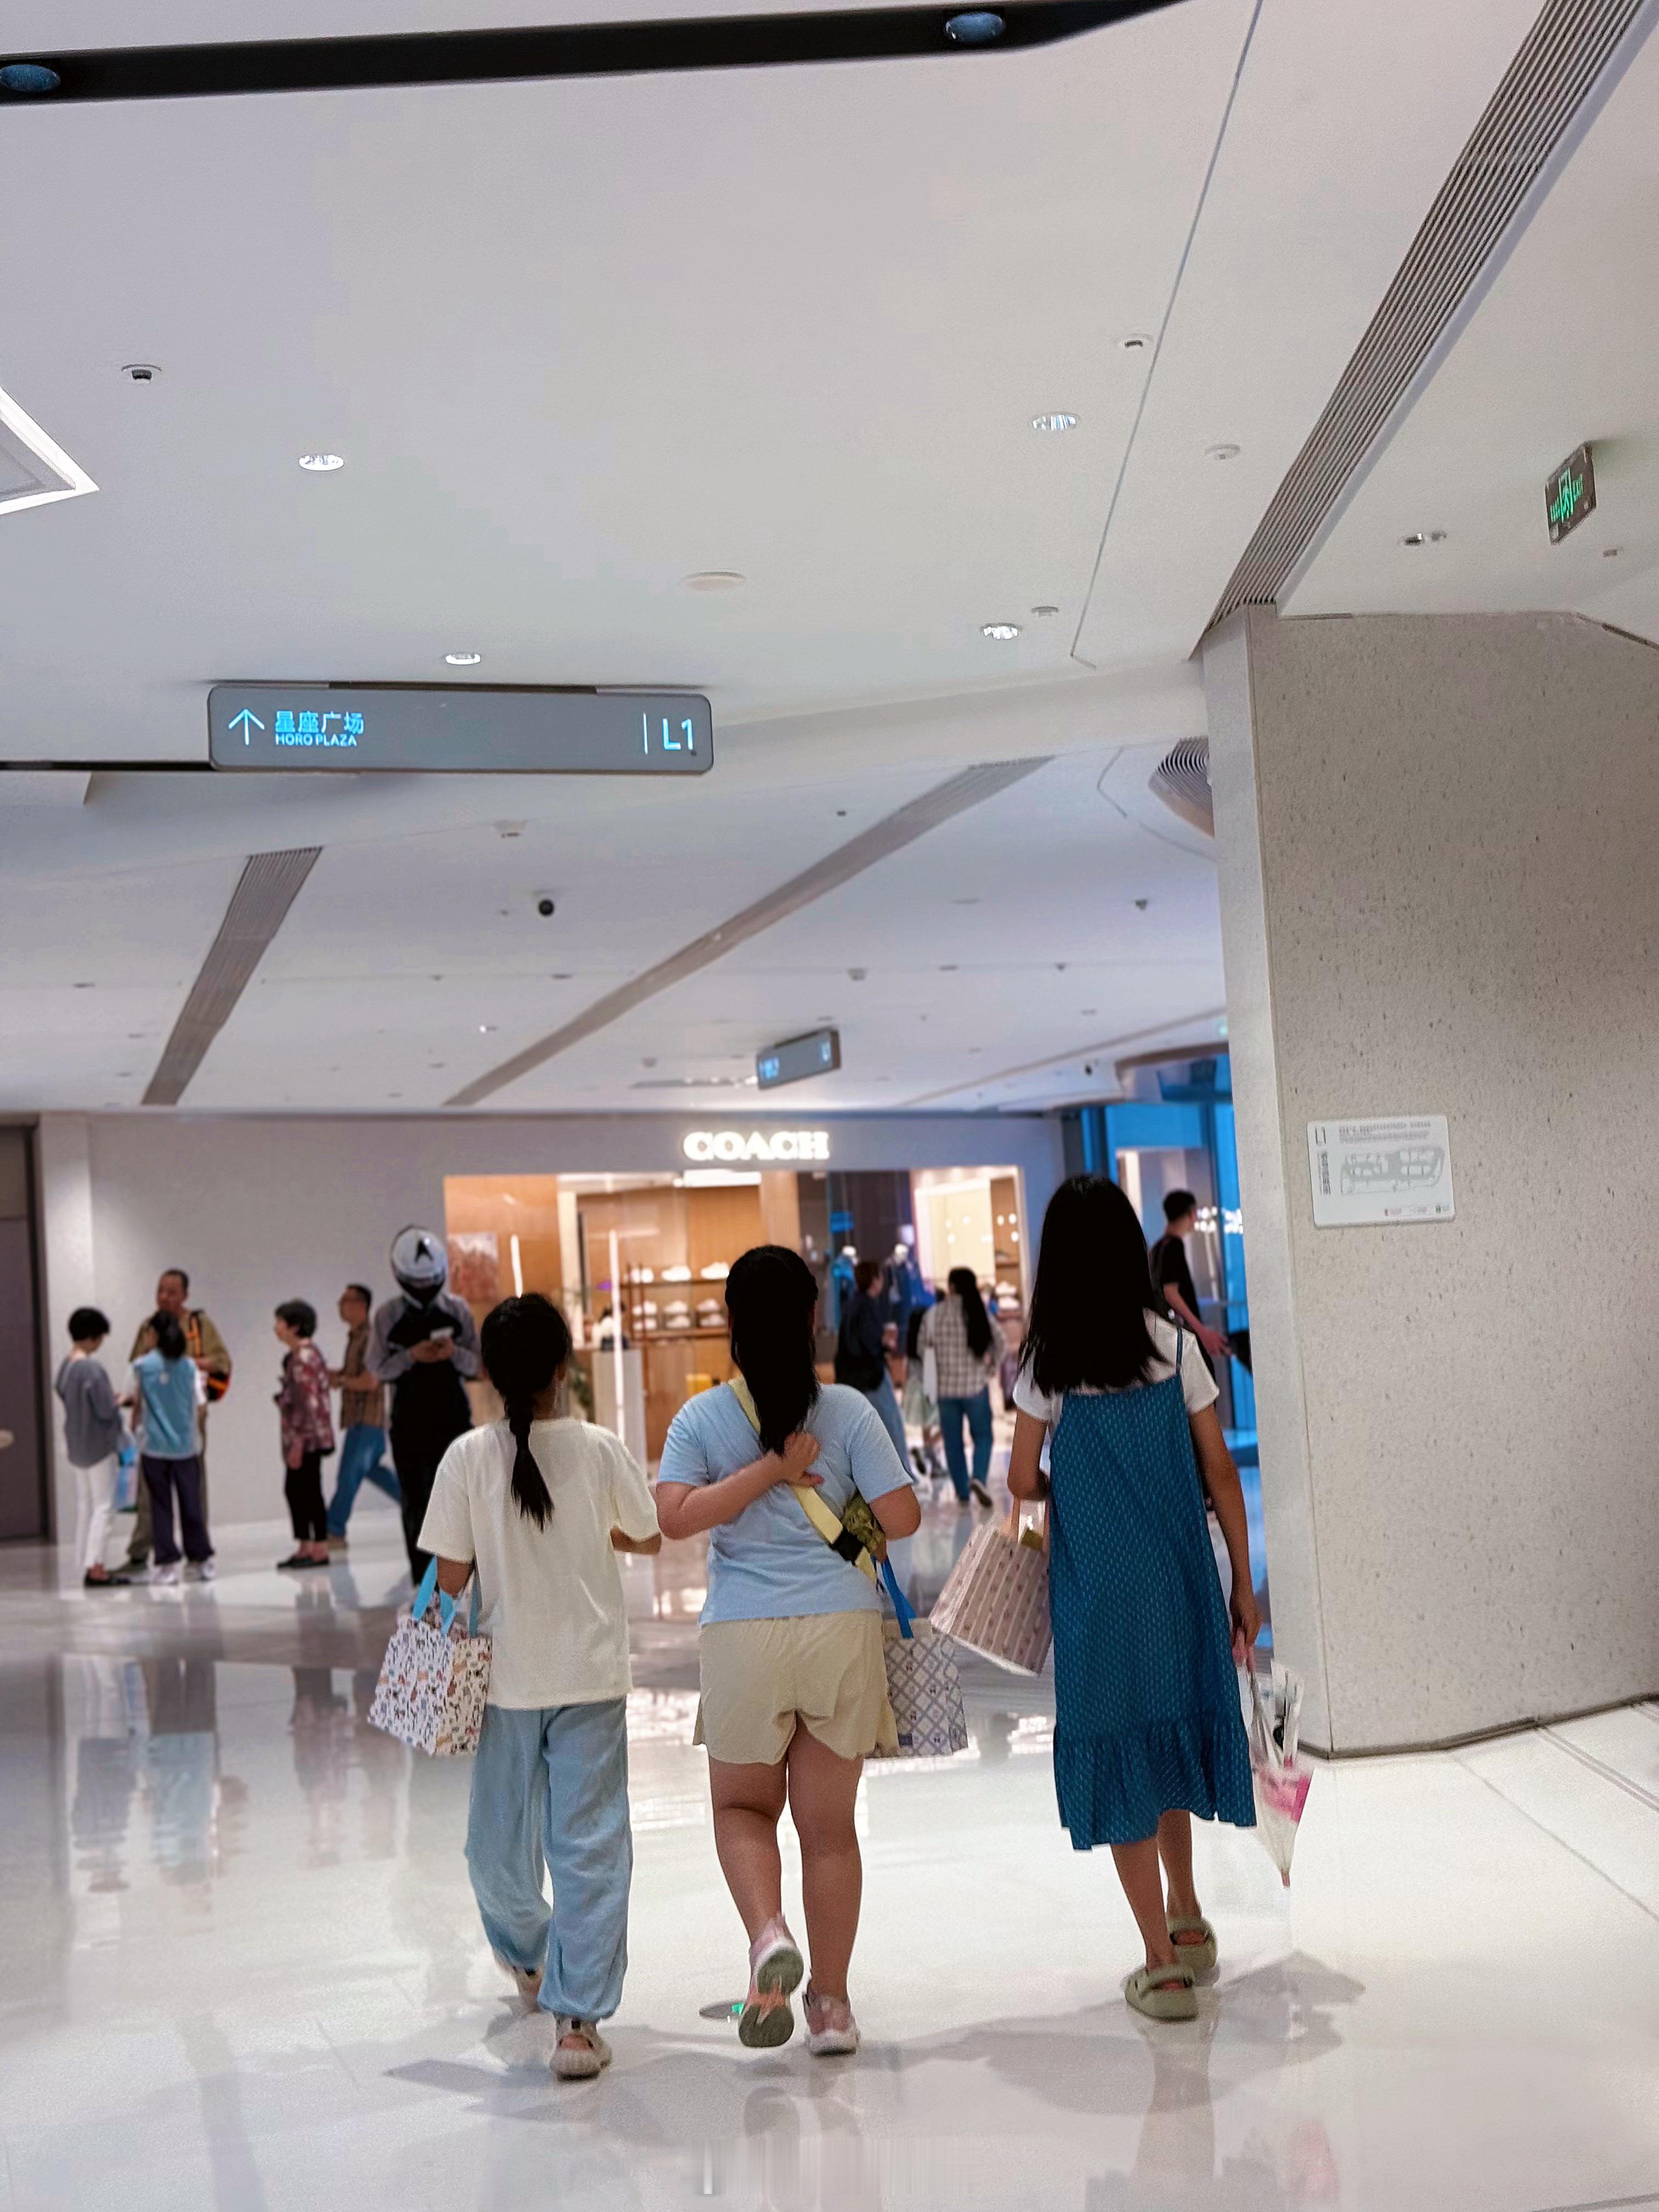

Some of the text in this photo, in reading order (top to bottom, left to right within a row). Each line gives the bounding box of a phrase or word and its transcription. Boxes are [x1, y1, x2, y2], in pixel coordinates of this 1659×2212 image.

[275, 710, 364, 734] 星座广场
[662, 718, 693, 750] L1
[275, 733, 357, 747] HORO PLAZA
[684, 1131, 830, 1160] COACH
